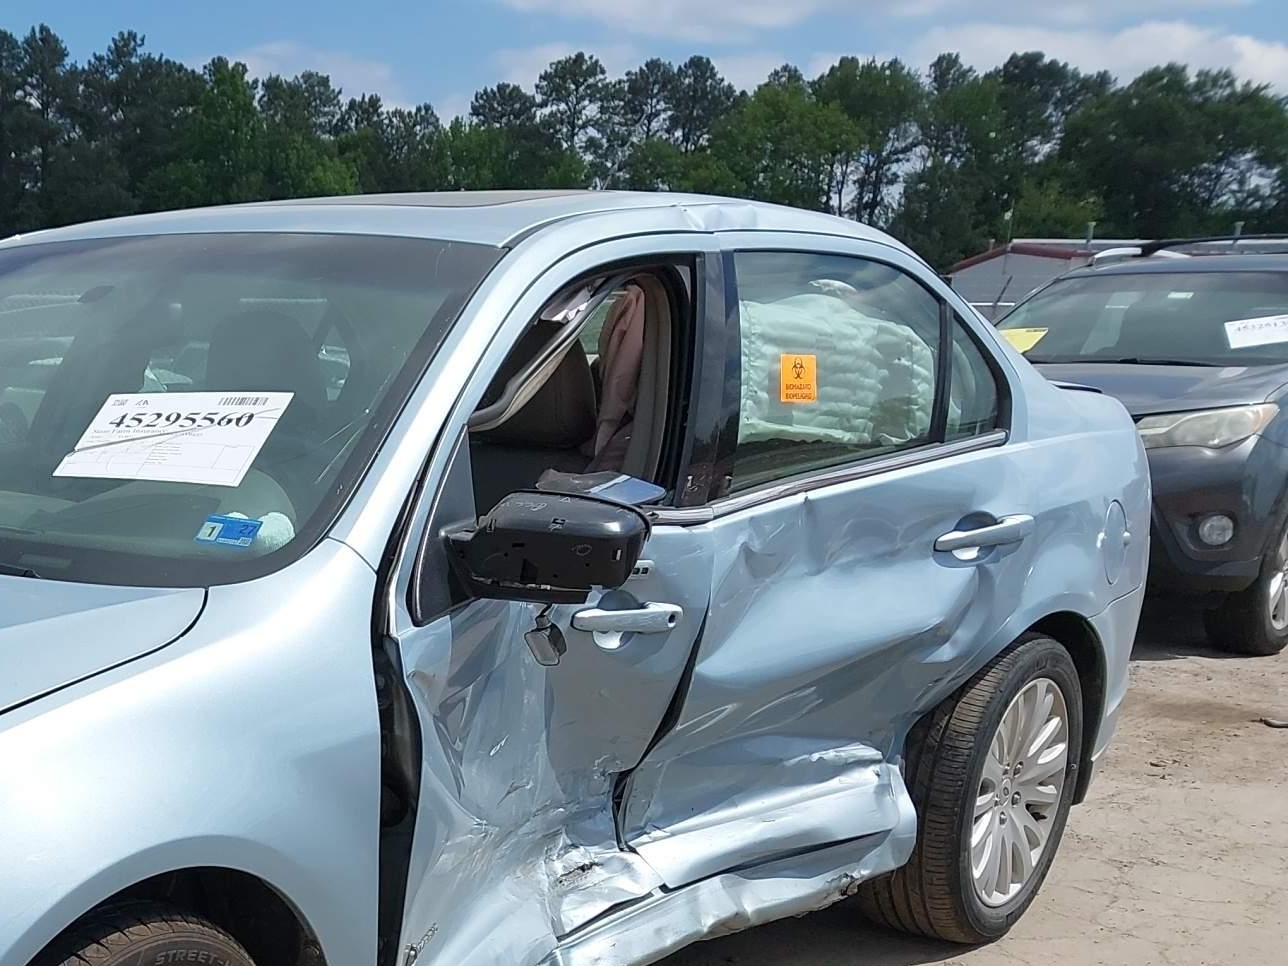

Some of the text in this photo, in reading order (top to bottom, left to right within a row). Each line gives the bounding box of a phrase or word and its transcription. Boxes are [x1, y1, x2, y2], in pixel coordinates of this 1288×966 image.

[109, 411, 255, 428] 45295560
[207, 525, 217, 537] 1
[239, 524, 257, 535] 27
